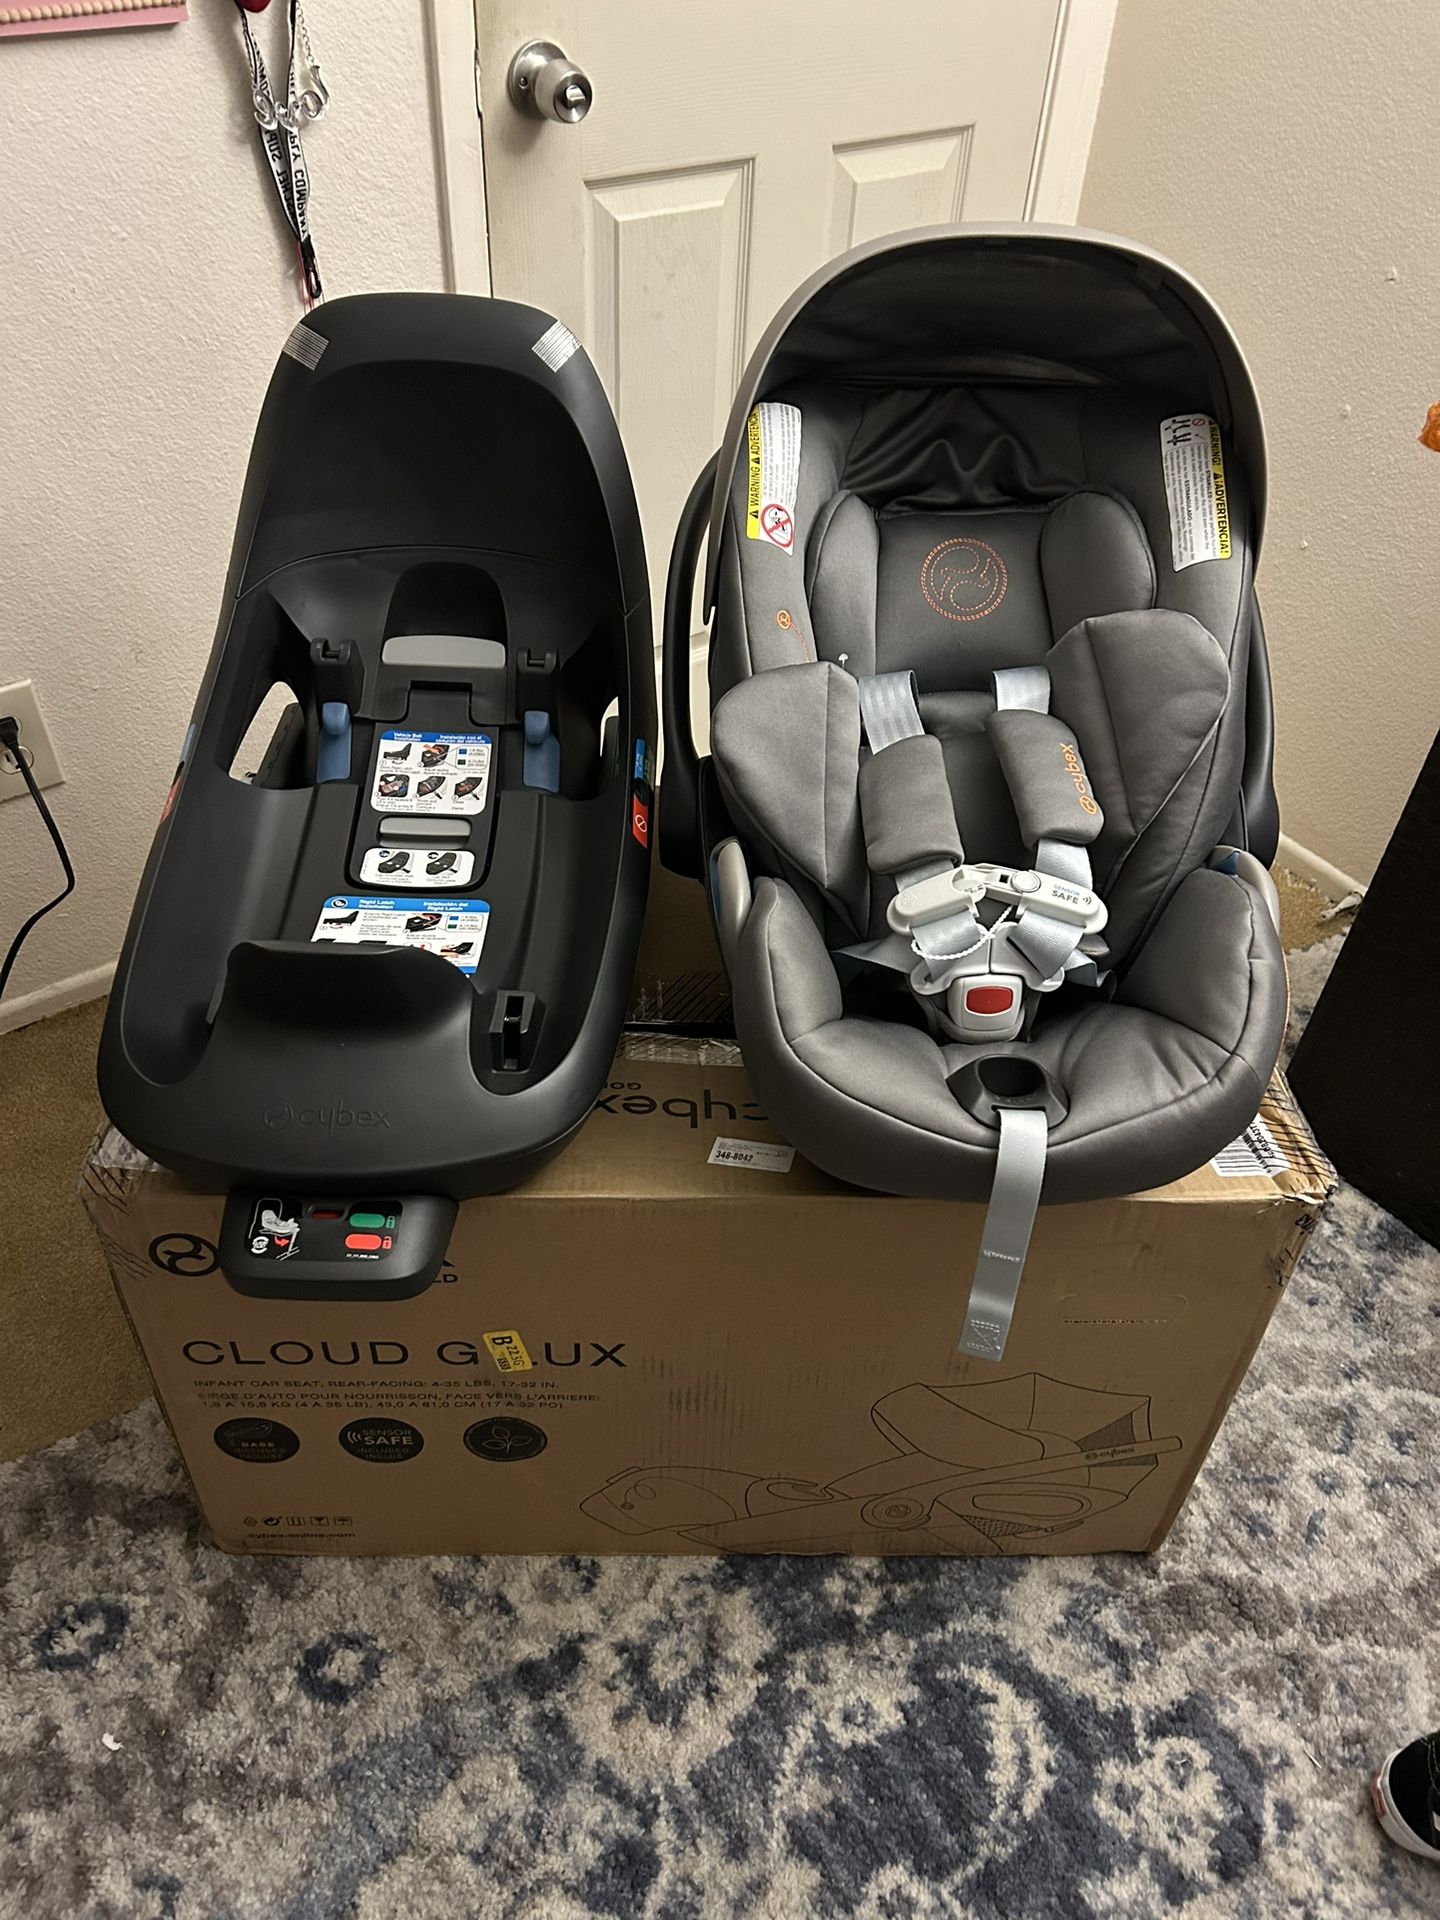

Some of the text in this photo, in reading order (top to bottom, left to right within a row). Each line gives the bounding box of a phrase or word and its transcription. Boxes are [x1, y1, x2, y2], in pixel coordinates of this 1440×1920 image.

[750, 466, 760, 507] WARNING
[1213, 480, 1229, 554] ¡ADVERTENCIA!
[1060, 742, 1088, 793] cybex
[1051, 889, 1080, 905] SAFE
[299, 1098, 392, 1135] cybex
[715, 1150, 754, 1162] 348-8042
[491, 1335, 513, 1346] B
[182, 1340, 409, 1365] CLOUD
[436, 1340, 479, 1366] G
[193, 1380, 246, 1388] INFANT
[250, 1380, 280, 1388] CAR
[284, 1380, 324, 1389] SEAT,
[328, 1381, 427, 1389] REAR-FACING:
[464, 1381, 496, 1389] LBS,
[243, 1392, 297, 1400] D'AUTO
[300, 1392, 340, 1400] POUR
[344, 1392, 442, 1402] NOURRISSON,
[446, 1393, 482, 1401] FACE
[486, 1392, 523, 1401] VERS
[270, 1401, 291, 1409] KG
[346, 1401, 373, 1409] LB),
[479, 1401, 500, 1410] (17
[364, 1436, 414, 1445] SAFE
[1099, 1447, 1135, 1459] cybex
